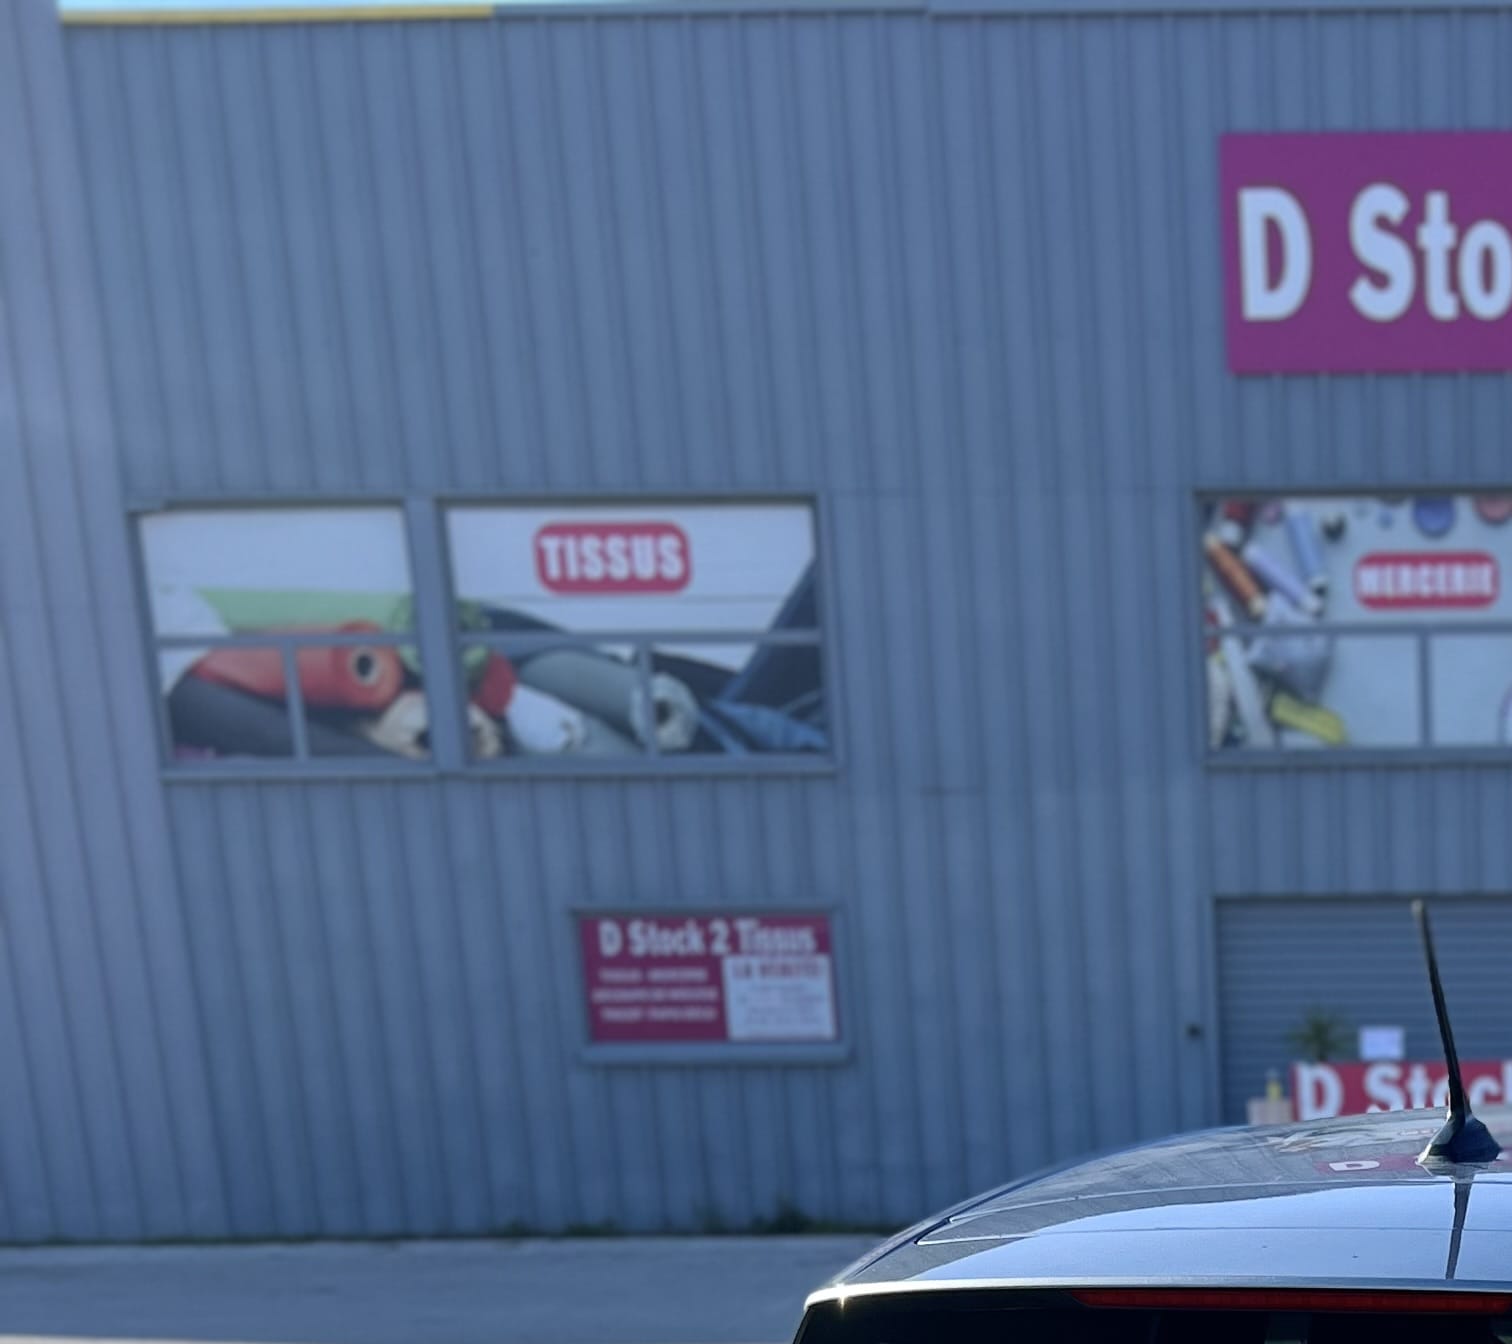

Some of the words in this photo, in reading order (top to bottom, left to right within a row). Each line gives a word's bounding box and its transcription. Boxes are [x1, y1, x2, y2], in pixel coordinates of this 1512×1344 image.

[1238, 186, 1313, 322] D
[540, 534, 684, 582] TISSUS
[1359, 562, 1494, 599] MERCERIE
[599, 920, 623, 957] D
[627, 919, 705, 957] Stock
[709, 920, 731, 955] 2
[735, 918, 817, 954] Tissus
[1296, 1062, 1344, 1121] D
